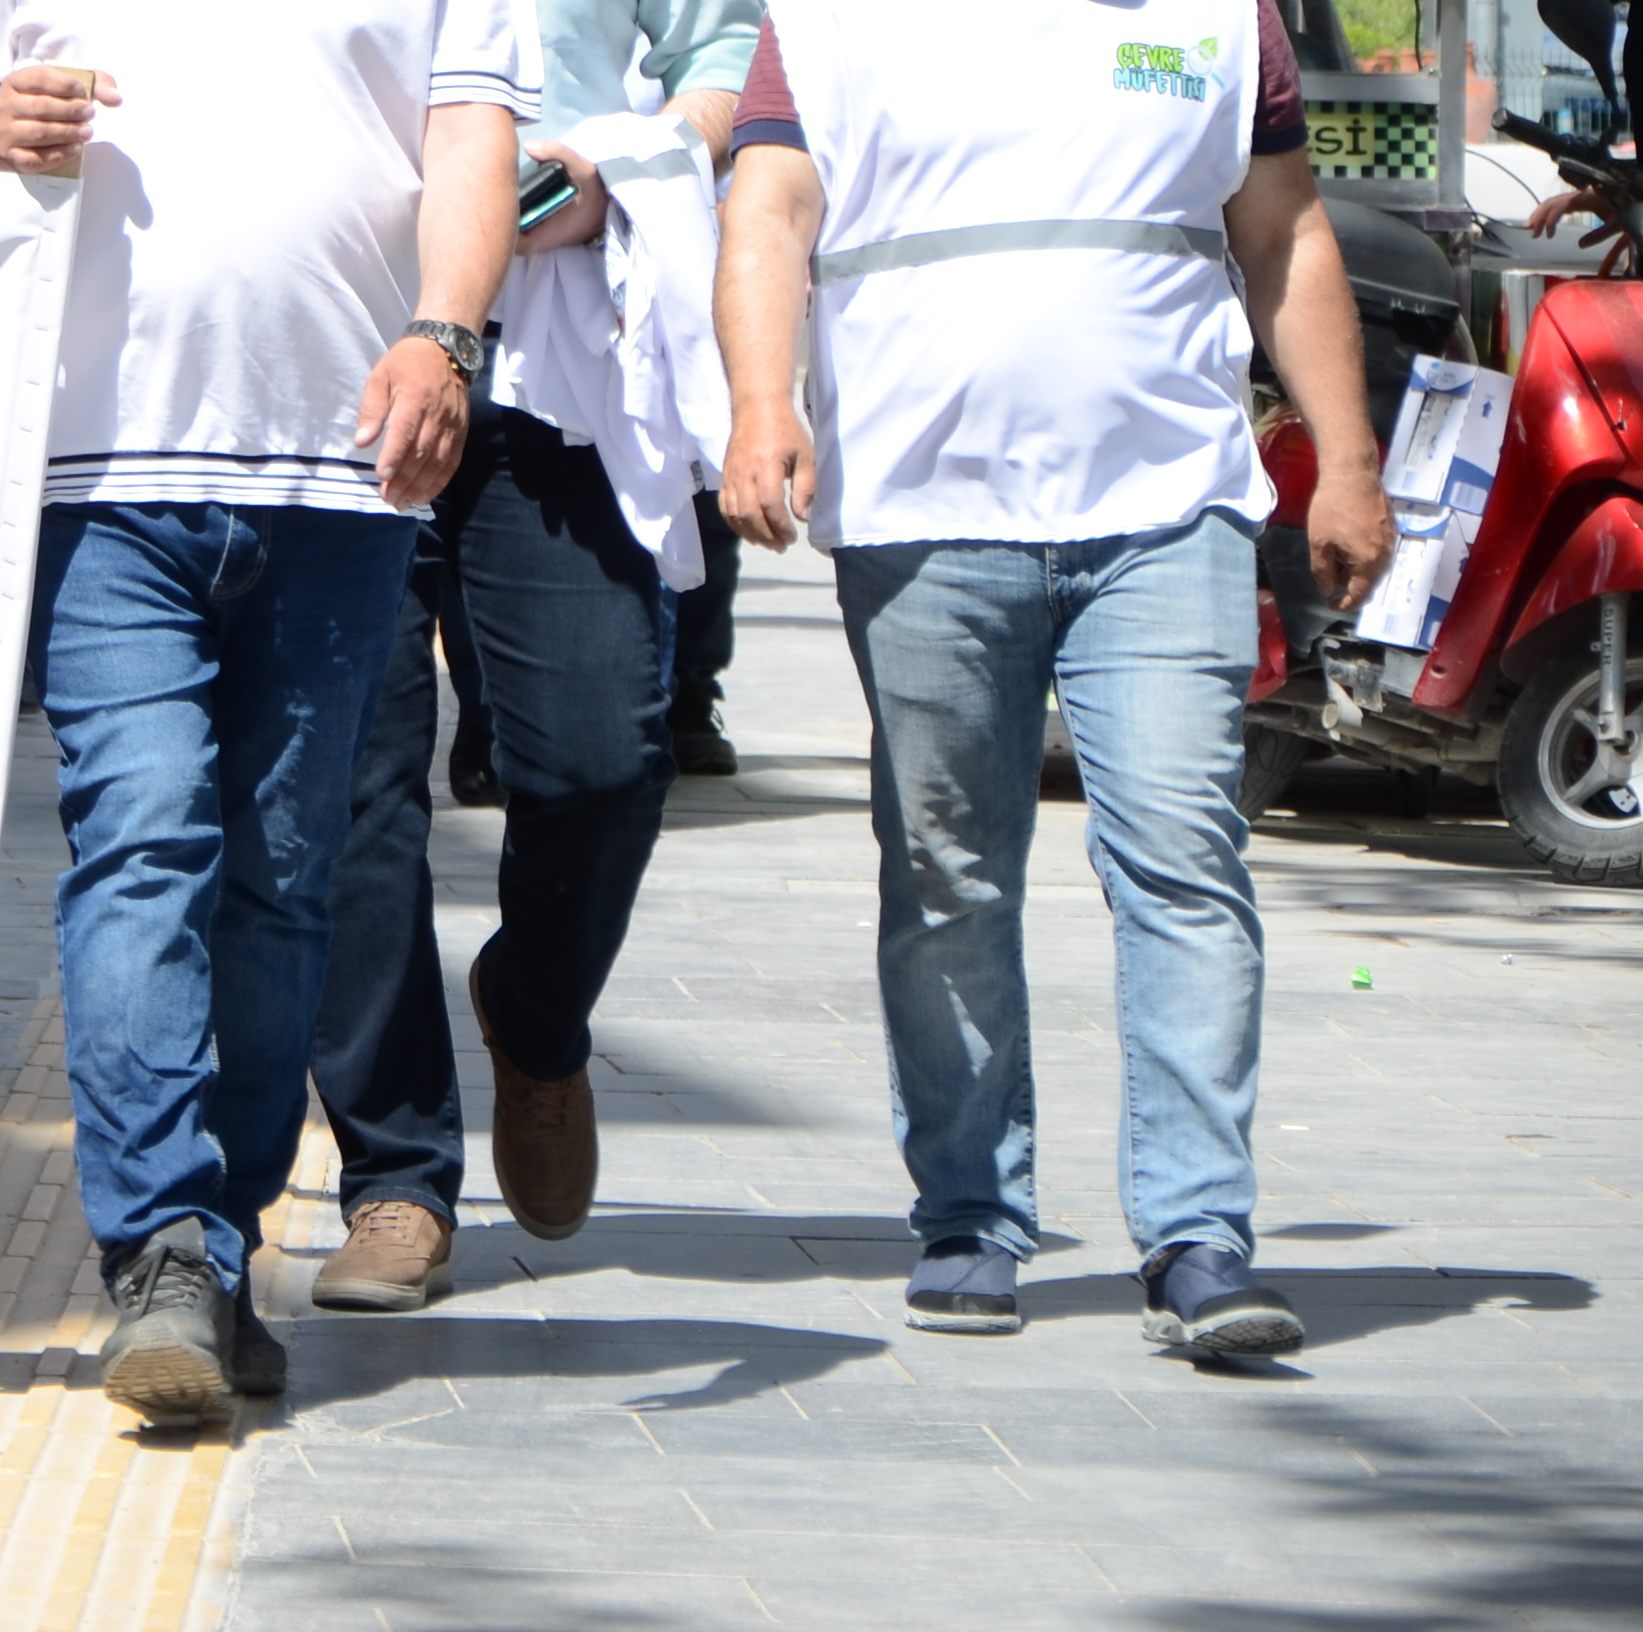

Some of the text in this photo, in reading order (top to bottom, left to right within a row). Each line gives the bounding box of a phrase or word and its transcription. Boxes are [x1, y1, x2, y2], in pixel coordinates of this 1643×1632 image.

[1116, 42, 1186, 74] ÇEVRE
[1307, 118, 1368, 157] Sİ
[1602, 607, 1615, 665] SUPER
